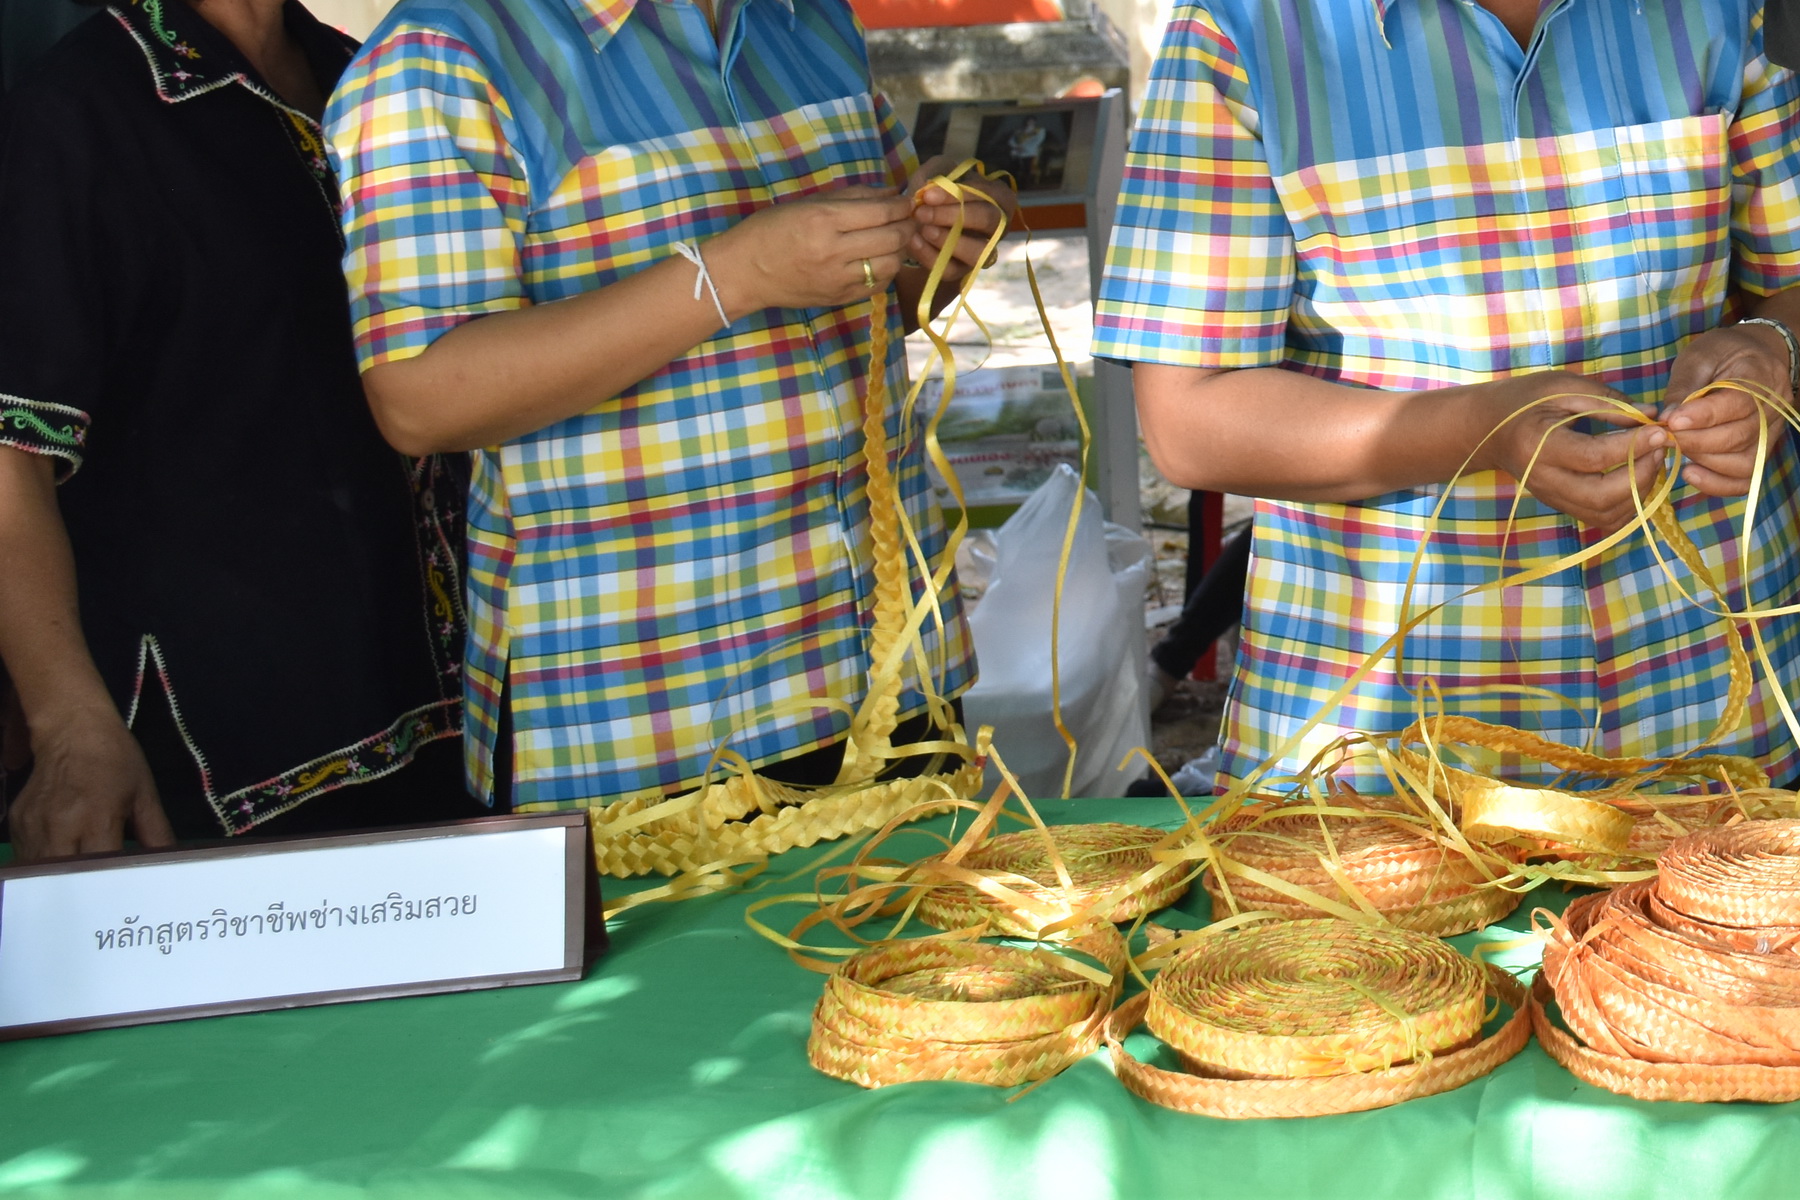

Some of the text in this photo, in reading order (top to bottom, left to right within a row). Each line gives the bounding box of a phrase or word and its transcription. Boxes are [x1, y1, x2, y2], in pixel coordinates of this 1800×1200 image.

[94, 891, 479, 955] หลักสูตรวิชาชีพช่างเสริมสวย
